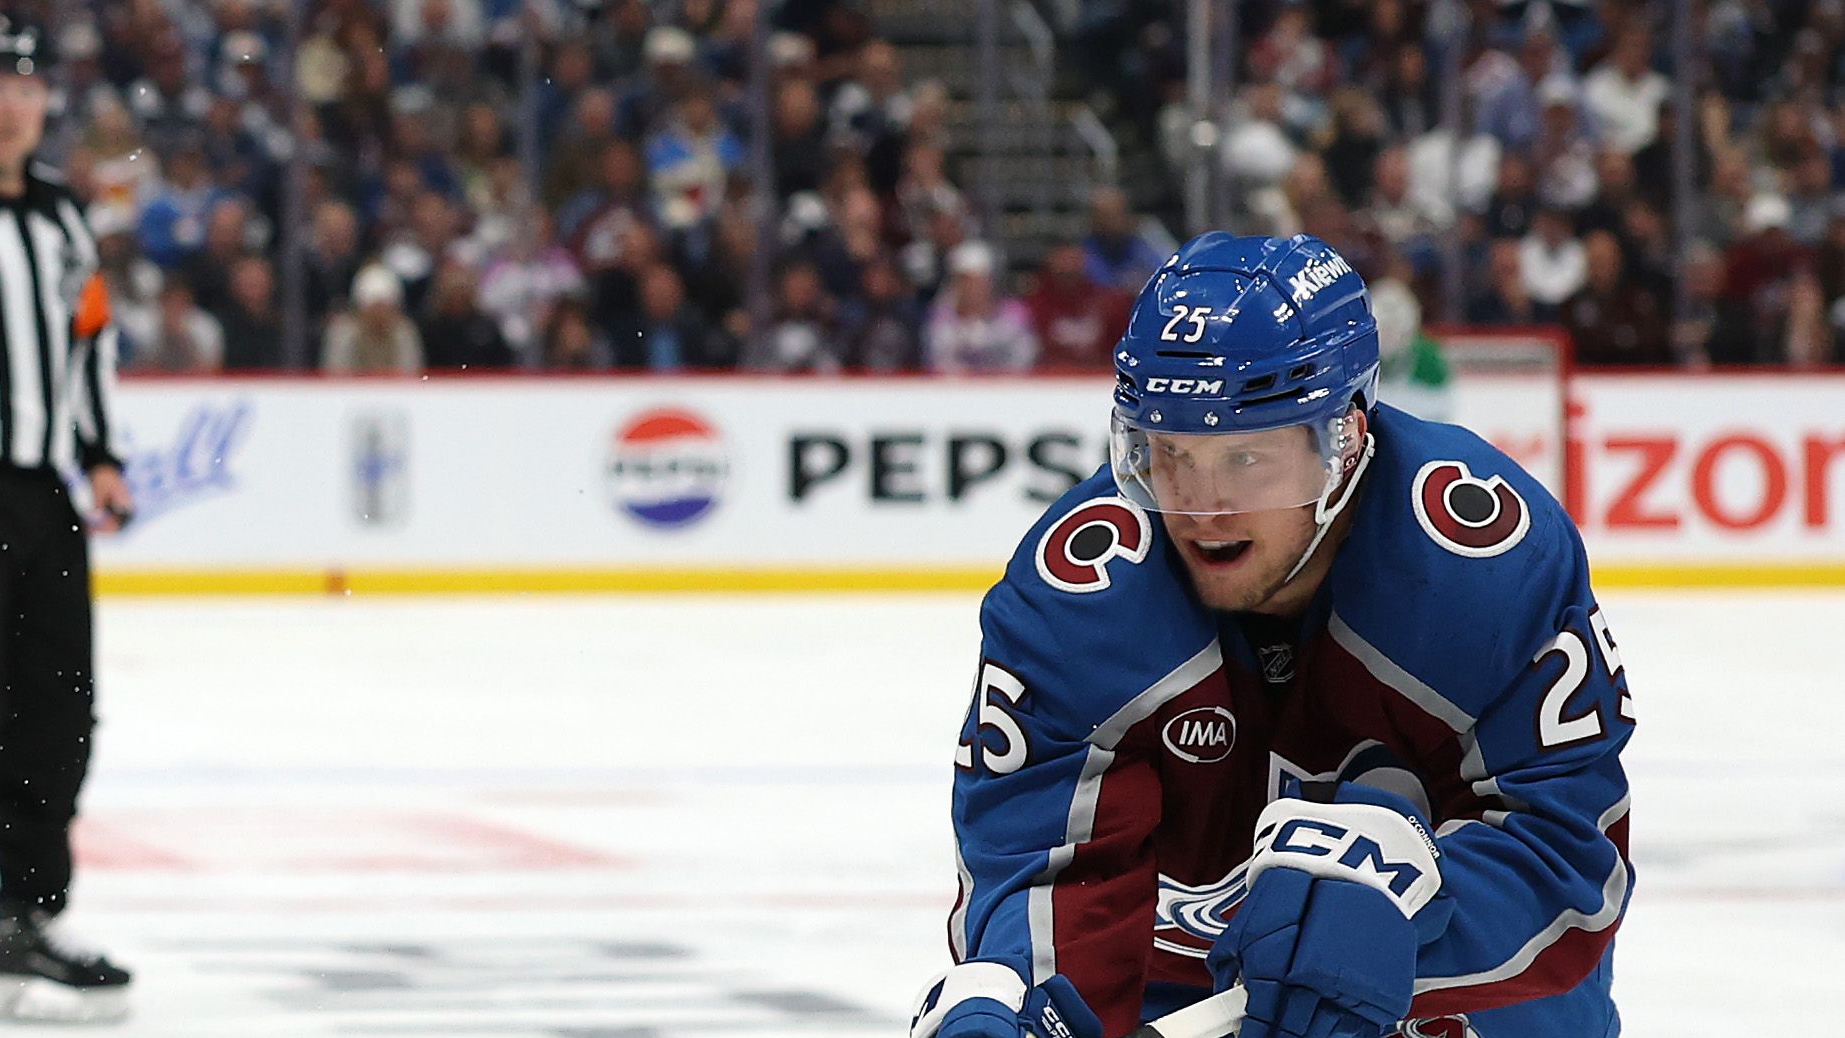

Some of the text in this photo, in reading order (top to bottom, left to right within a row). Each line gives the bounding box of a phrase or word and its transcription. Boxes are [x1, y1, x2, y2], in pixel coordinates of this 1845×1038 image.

[1160, 305, 1212, 343] 25
[1145, 377, 1224, 395] CCM
[789, 432, 1084, 503] PEPS
[1178, 720, 1228, 746] IMA
[1407, 815, 1441, 860] O'CONNOR
